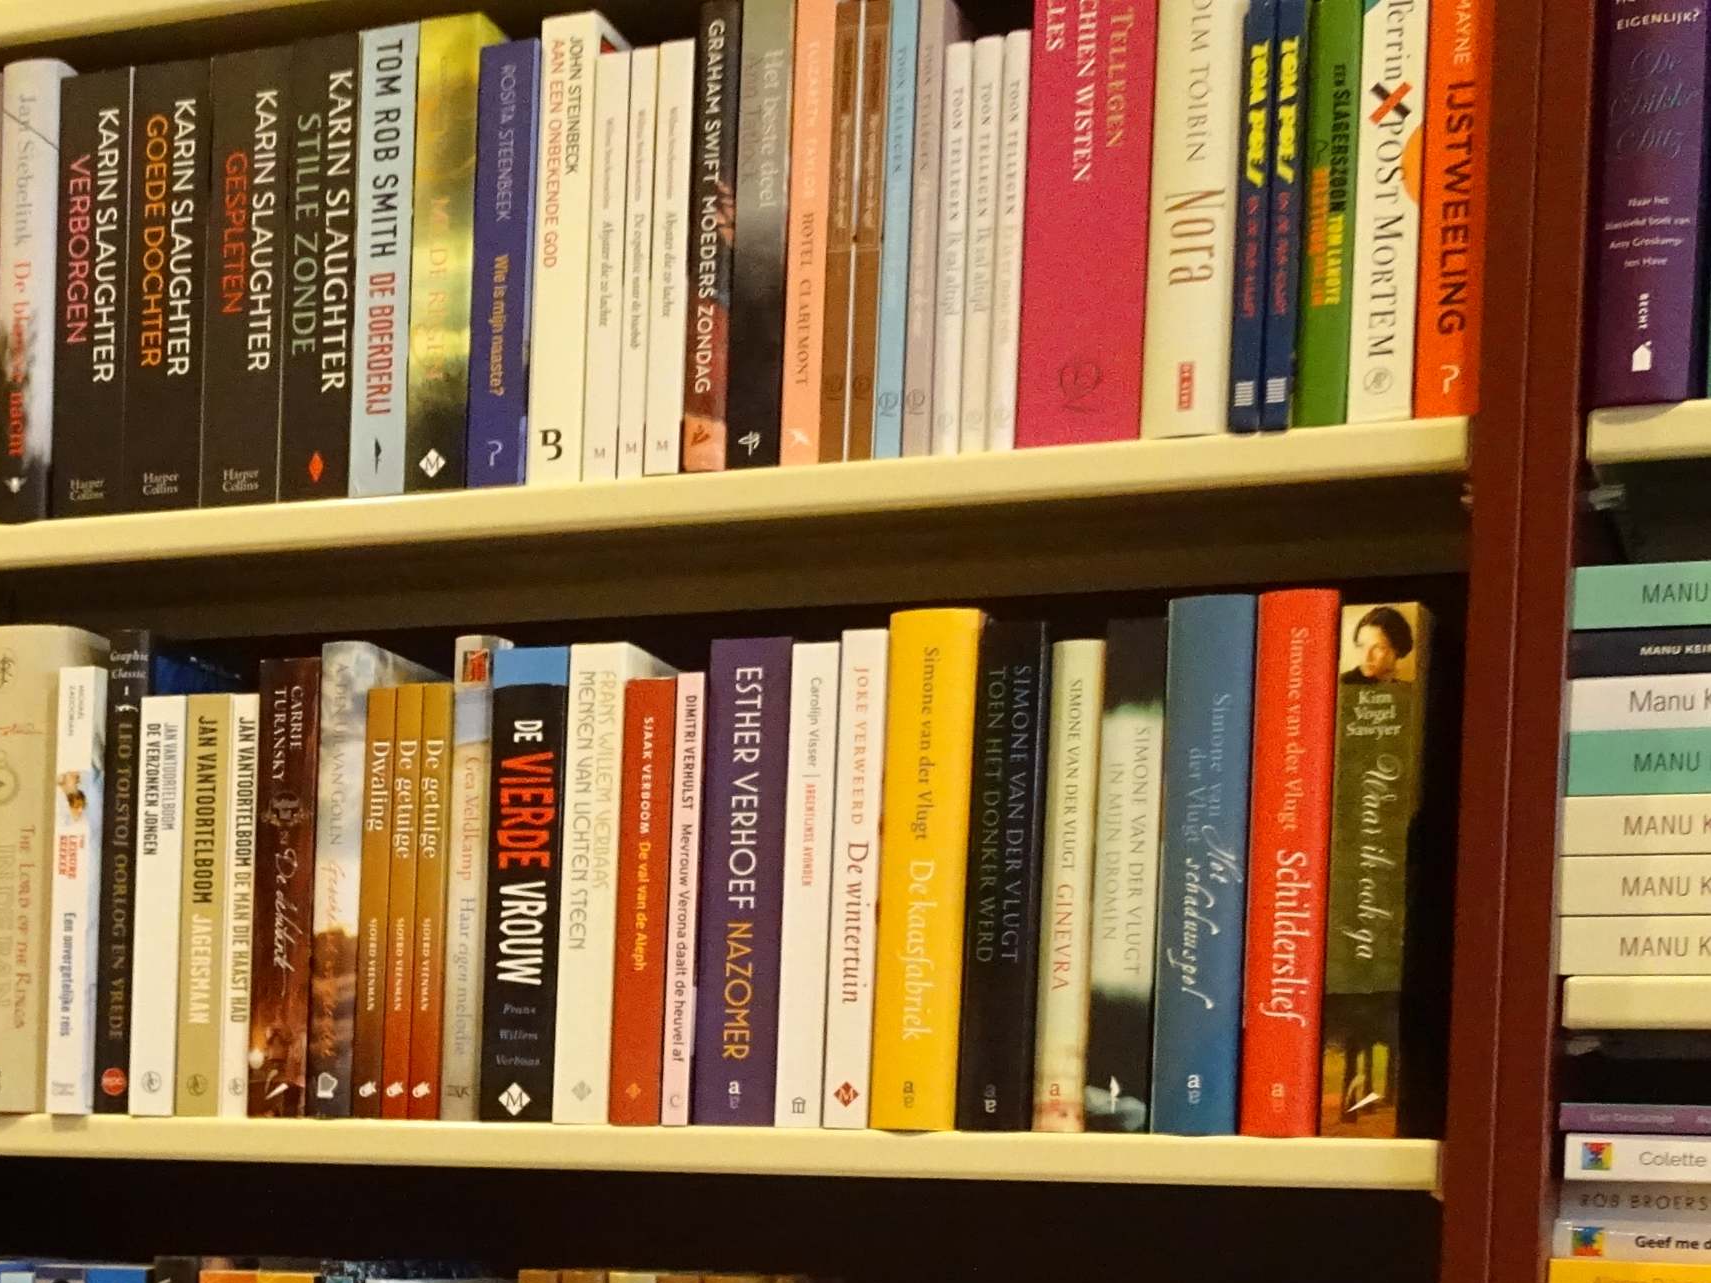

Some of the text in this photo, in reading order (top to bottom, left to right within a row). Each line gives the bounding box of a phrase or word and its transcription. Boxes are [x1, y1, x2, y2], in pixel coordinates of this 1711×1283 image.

[542, 39, 565, 269] AAN EEN ONBEKENDE GOD
[565, 37, 584, 175] JOHN STEINBECK
[66, 155, 91, 344] VERBORGEN
[92, 108, 120, 383] KARIN SLAUGHTER
[142, 115, 168, 366] GOEDE DOCHTER
[167, 100, 196, 376] KARIN SLAUGHTER
[221, 152, 248, 313] GESPLETEN
[248, 90, 278, 372] KARIN SLAUGHTER
[292, 114, 321, 355] STILLE ZONDE
[322, 71, 353, 393] KARIN SLAUGHTER
[365, 40, 402, 417] TOM ROB SMITH DE BOERDERIJ
[694, 21, 725, 394] GRAHAM SWIFT MOEDERS ZONDAG
[1437, 80, 1475, 335] IJSTWEELING
[1642, 583, 1708, 604] MANU
[366, 742, 390, 831] Dwaling
[1346, 722, 1400, 738] Sawyer
[1354, 706, 1395, 722] Vogel
[1359, 691, 1390, 705] Kim
[1629, 690, 1695, 713] Manu
[190, 716, 217, 1024] JAN VANTOORTELBOOM JAGERSMAN
[393, 740, 419, 859] De getuige
[419, 739, 444, 859] De getuige
[497, 719, 555, 985] DE VIERDE VROUW
[722, 668, 763, 1062] ESTHER VERHOEF NAZOMER
[902, 648, 940, 1040] Simone van der Vlugt De kaasfabriek
[1622, 877, 1689, 897] MANU
[1624, 816, 1692, 836] MANU
[1052, 884, 1076, 991] GINEVRA
[1261, 849, 1306, 1026] Schilderslief
[1639, 1150, 1707, 1168] Colette
